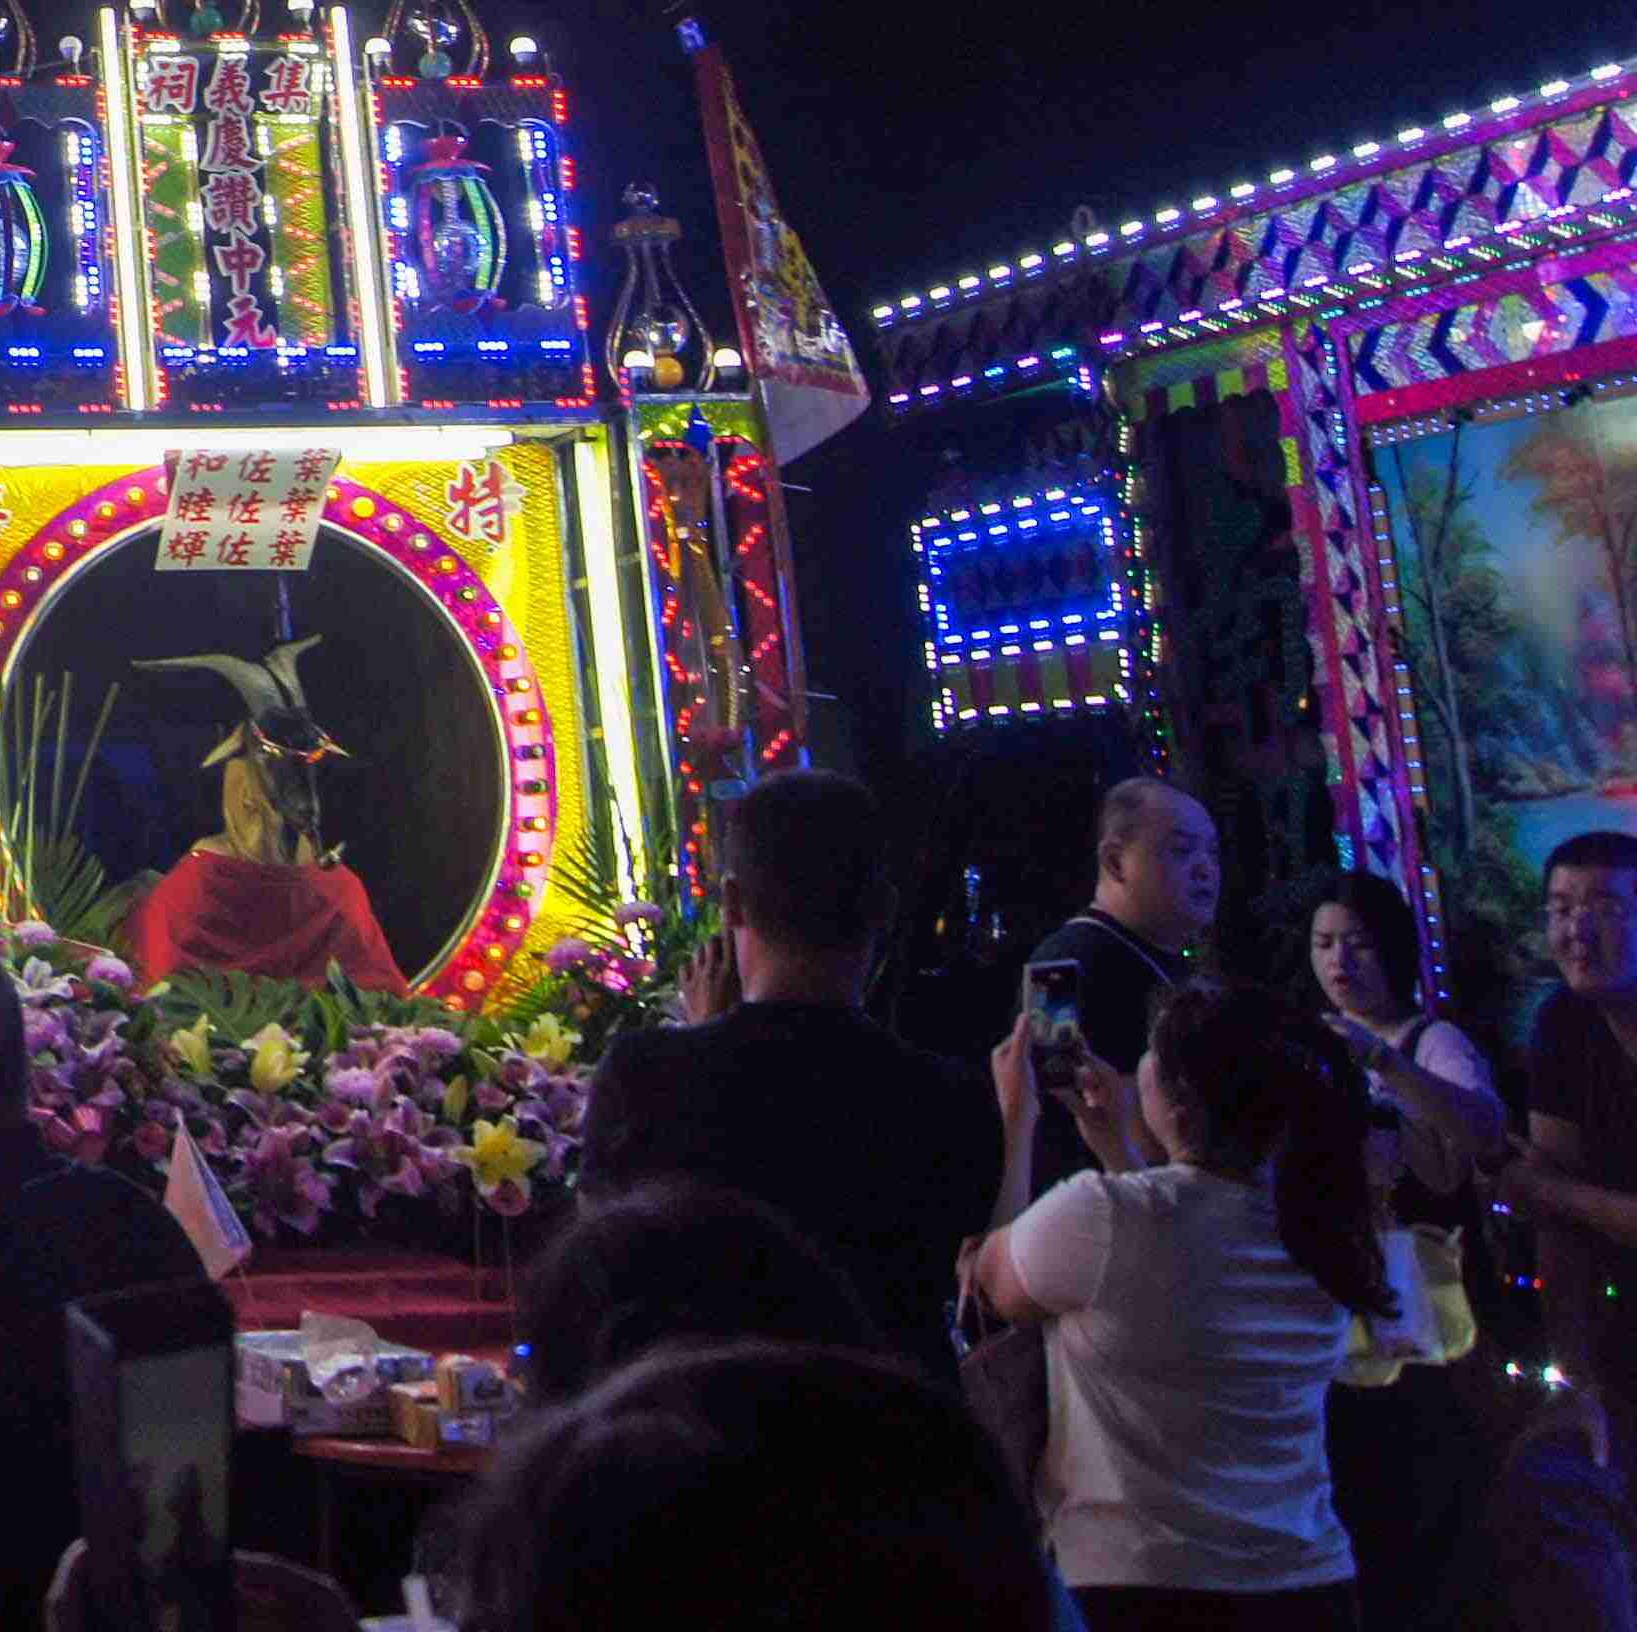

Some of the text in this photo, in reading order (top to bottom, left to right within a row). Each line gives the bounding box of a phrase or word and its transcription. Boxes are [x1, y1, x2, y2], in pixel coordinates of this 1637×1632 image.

[148, 53, 310, 113] 集義祠
[177, 488, 318, 523] 葉佐睦
[445, 459, 515, 546] 特
[165, 529, 307, 567] 葉佐輝
